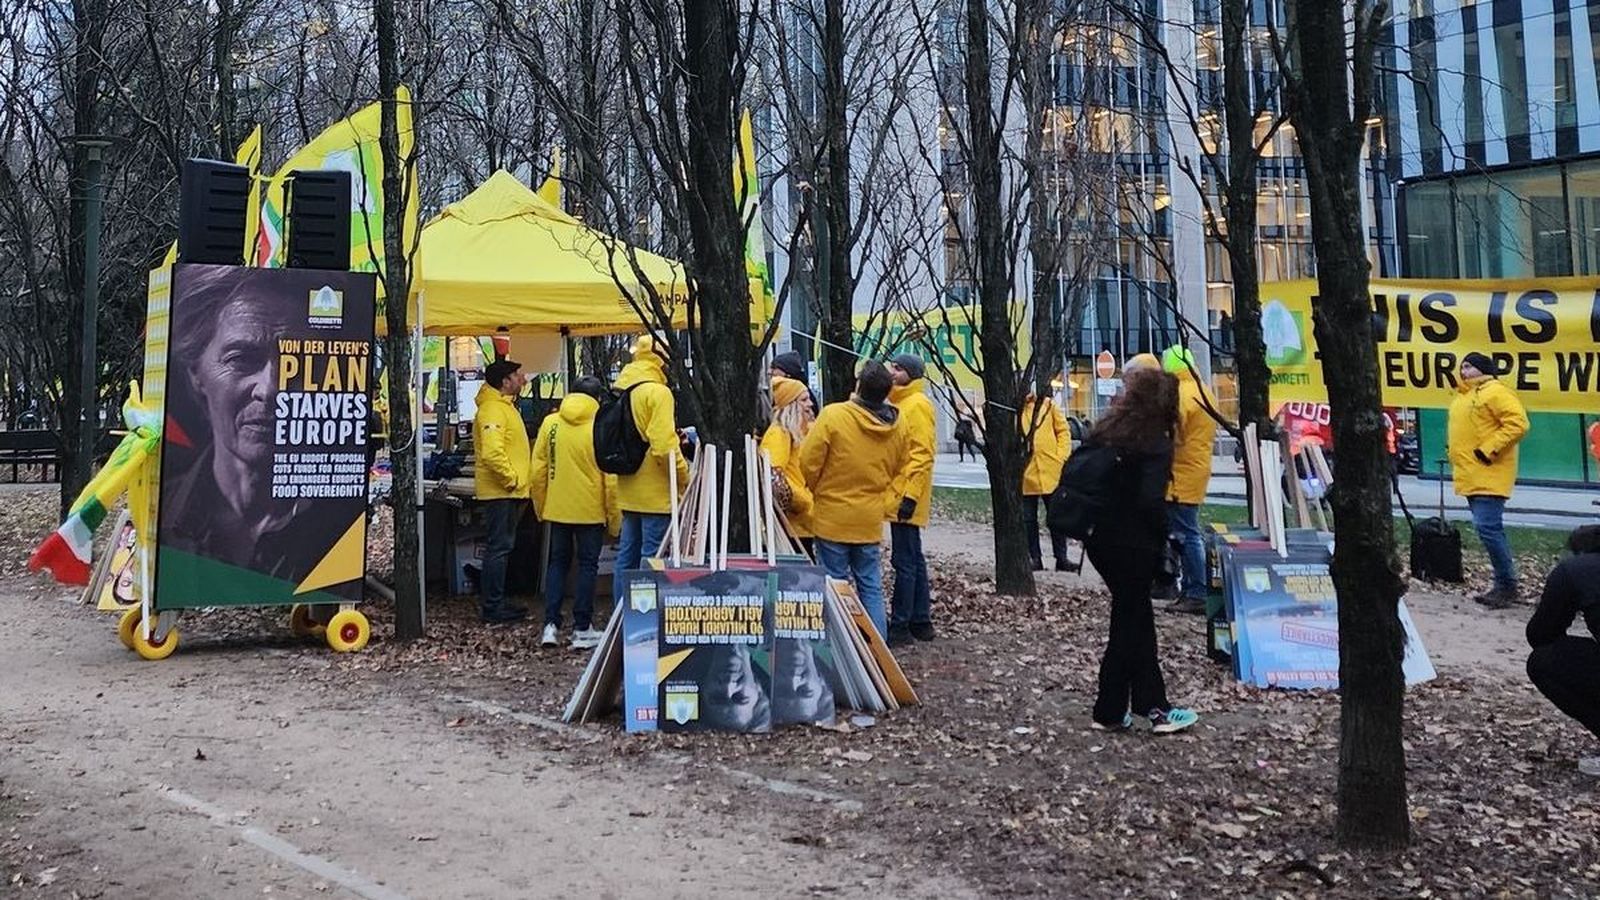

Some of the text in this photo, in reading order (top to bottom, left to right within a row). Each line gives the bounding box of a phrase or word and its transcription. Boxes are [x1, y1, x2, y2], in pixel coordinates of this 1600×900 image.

[1487, 289, 1559, 343] IS
[279, 340, 370, 355] VON DER LEYEN'S
[279, 354, 367, 392] PLAN
[1384, 351, 1600, 392] EURPE W
[275, 392, 367, 419] STARVES
[275, 420, 366, 445] EUROPE
[274, 454, 365, 463] THE EU BUDGET PROPOSAL
[273, 464, 365, 473] CUTS FUNDS FOR FARMERS
[273, 474, 365, 484] AND ENDANGERS EUROPE'S
[272, 485, 365, 498] FOOD SOVEREIGNTY
[665, 606, 736, 621] AGRICOLTORI
[739, 606, 763, 620] AGLI
[800, 602, 823, 617] AGLI
[665, 621, 764, 634] 90 MILIARDI RUBATI
[775, 616, 825, 630] 90 MILIAR
